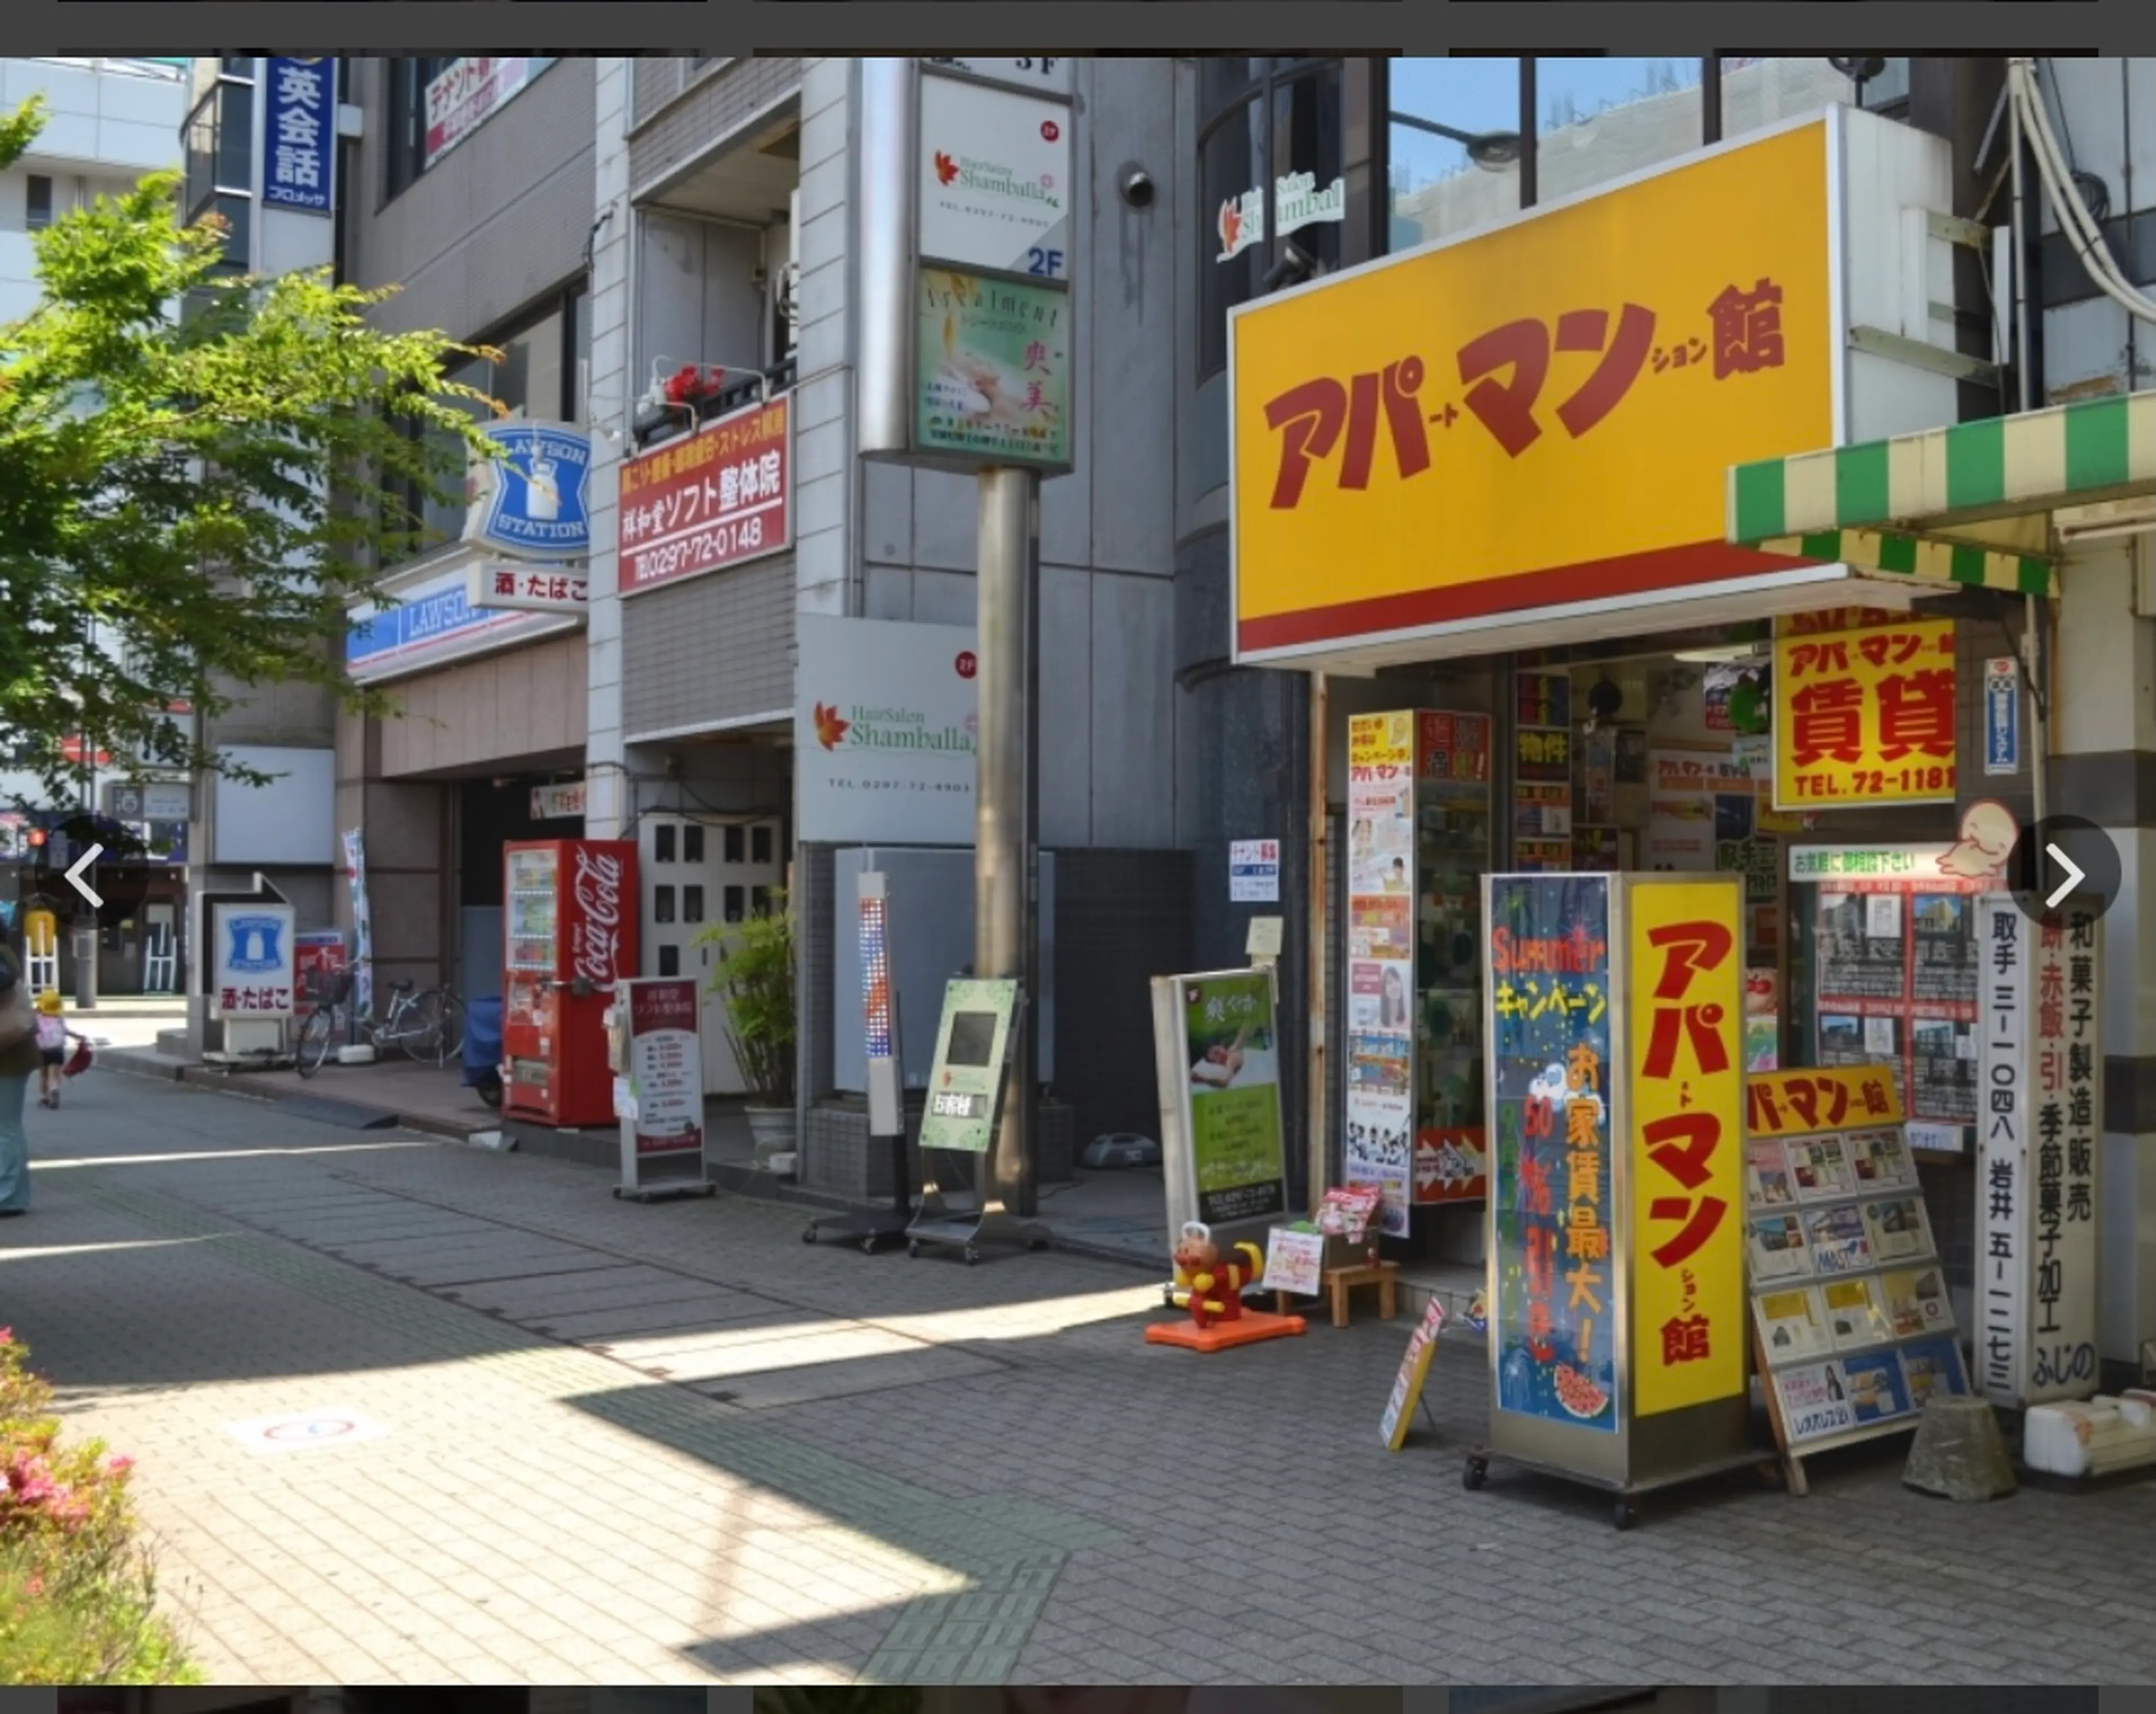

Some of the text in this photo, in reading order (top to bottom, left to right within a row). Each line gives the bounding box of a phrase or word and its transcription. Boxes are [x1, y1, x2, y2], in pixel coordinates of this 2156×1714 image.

[276, 67, 322, 187] 英会話
[268, 185, 325, 206] プロメッサ
[1028, 248, 1062, 275] 2F
[1263, 277, 1784, 509] アパートマンション館
[497, 515, 585, 538] STATION
[495, 572, 588, 601] 酒・たばこ
[409, 590, 477, 637] LAWSO
[850, 722, 971, 752] Shamballa
[1790, 669, 1955, 768] 賃貸
[574, 845, 623, 979] Coca-Cola
[1492, 926, 1605, 973] Summer
[1991, 910, 2017, 975] 取手
[222, 987, 290, 1010] 酒・たばこ
[1495, 978, 1606, 1024] キャンペーン
[1642, 920, 1733, 1366] アパートマンション館
[1989, 1158, 2013, 1220] 岩井
[2032, 1342, 2095, 1387] ふじの
